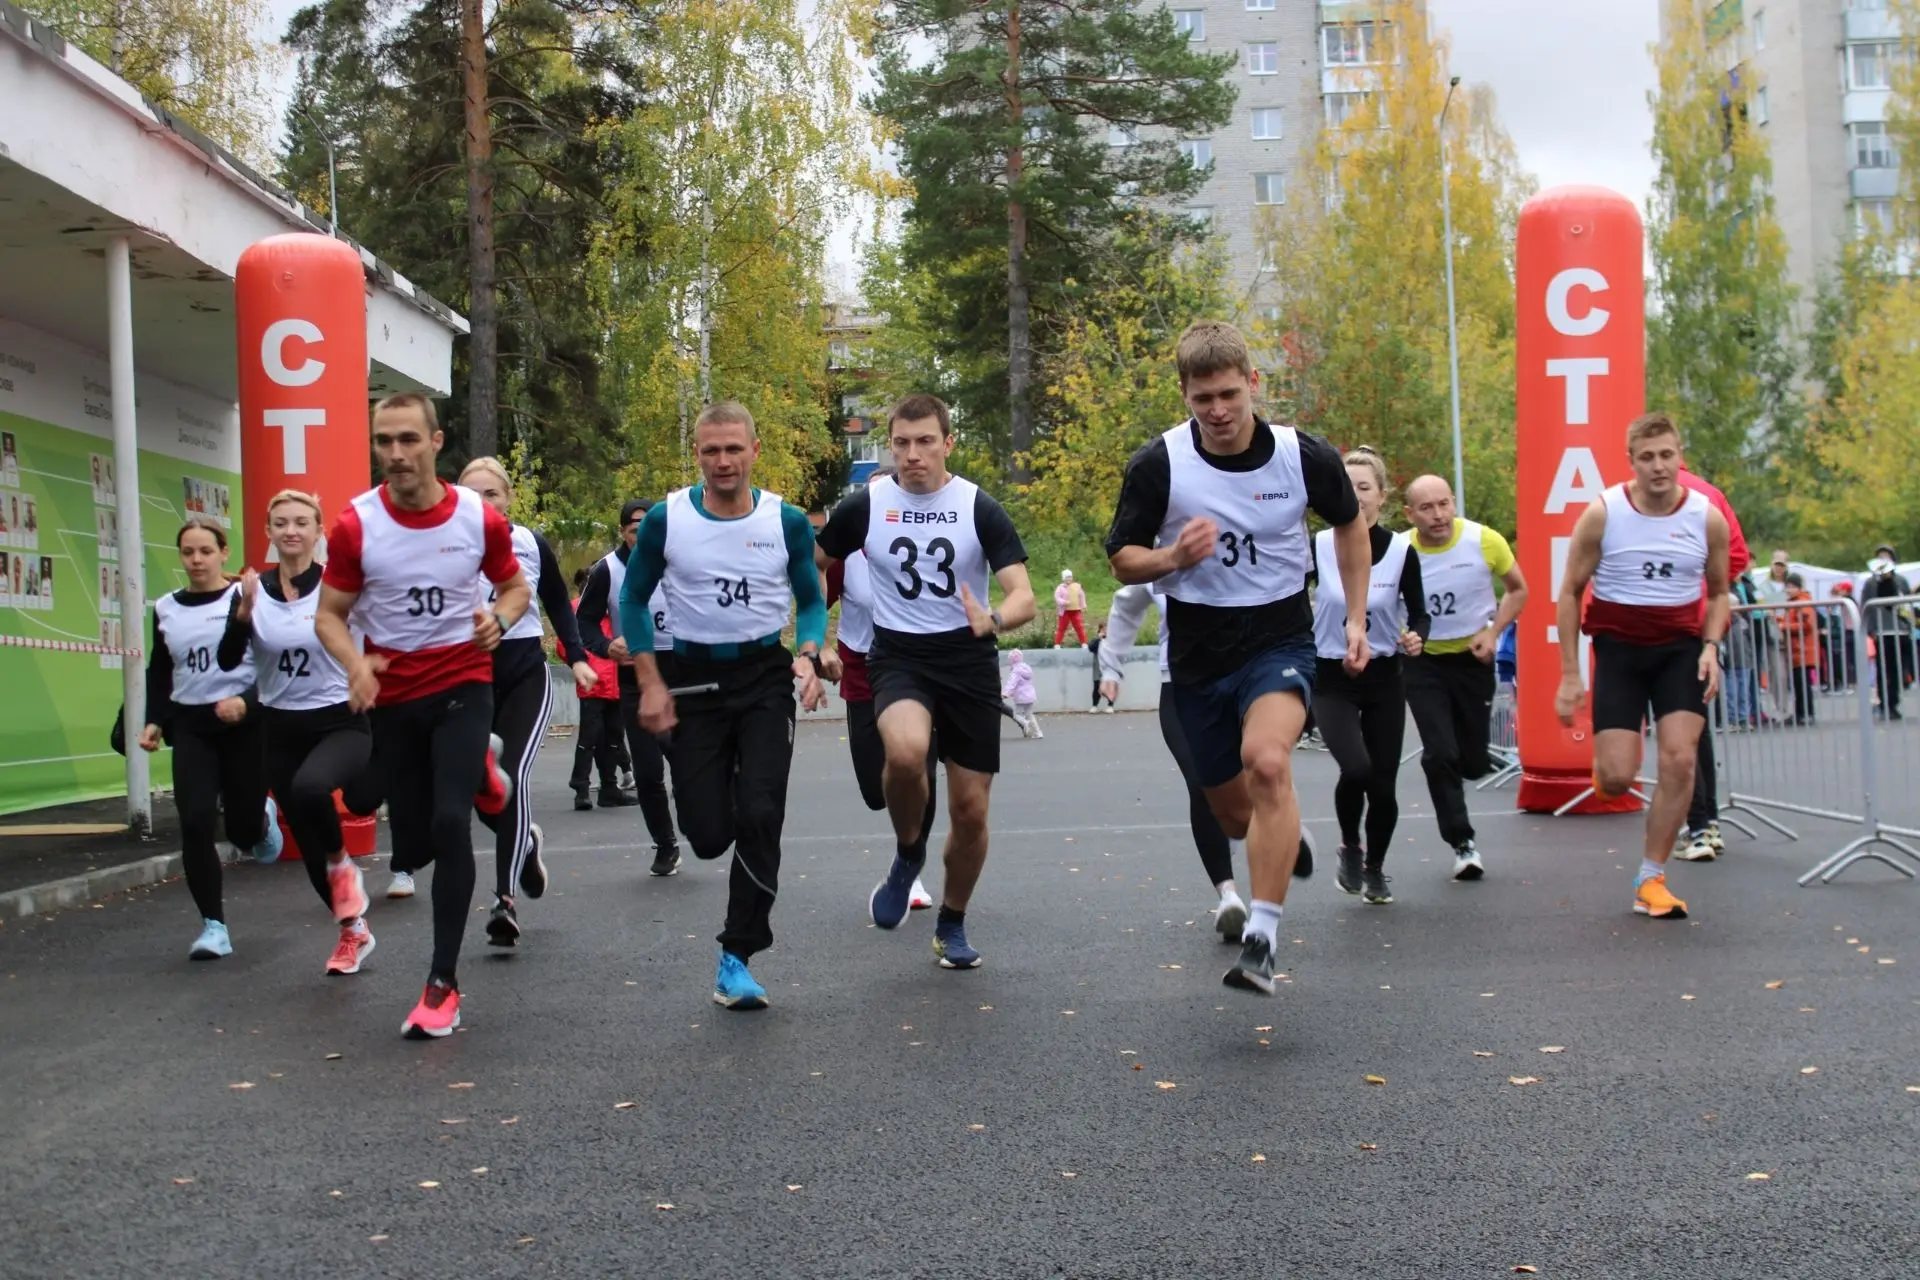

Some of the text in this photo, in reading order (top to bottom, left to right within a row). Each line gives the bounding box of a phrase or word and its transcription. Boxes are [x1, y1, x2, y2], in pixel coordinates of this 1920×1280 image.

[1262, 492, 1289, 501] ЕВРАЗ
[902, 511, 958, 524] ЕВРАЗ
[1220, 531, 1257, 567] 31
[889, 536, 956, 600] 33
[407, 586, 443, 617] 30
[714, 576, 751, 607] 34
[1430, 592, 1456, 616] 32
[187, 647, 210, 673] 40
[278, 648, 310, 678] 42
